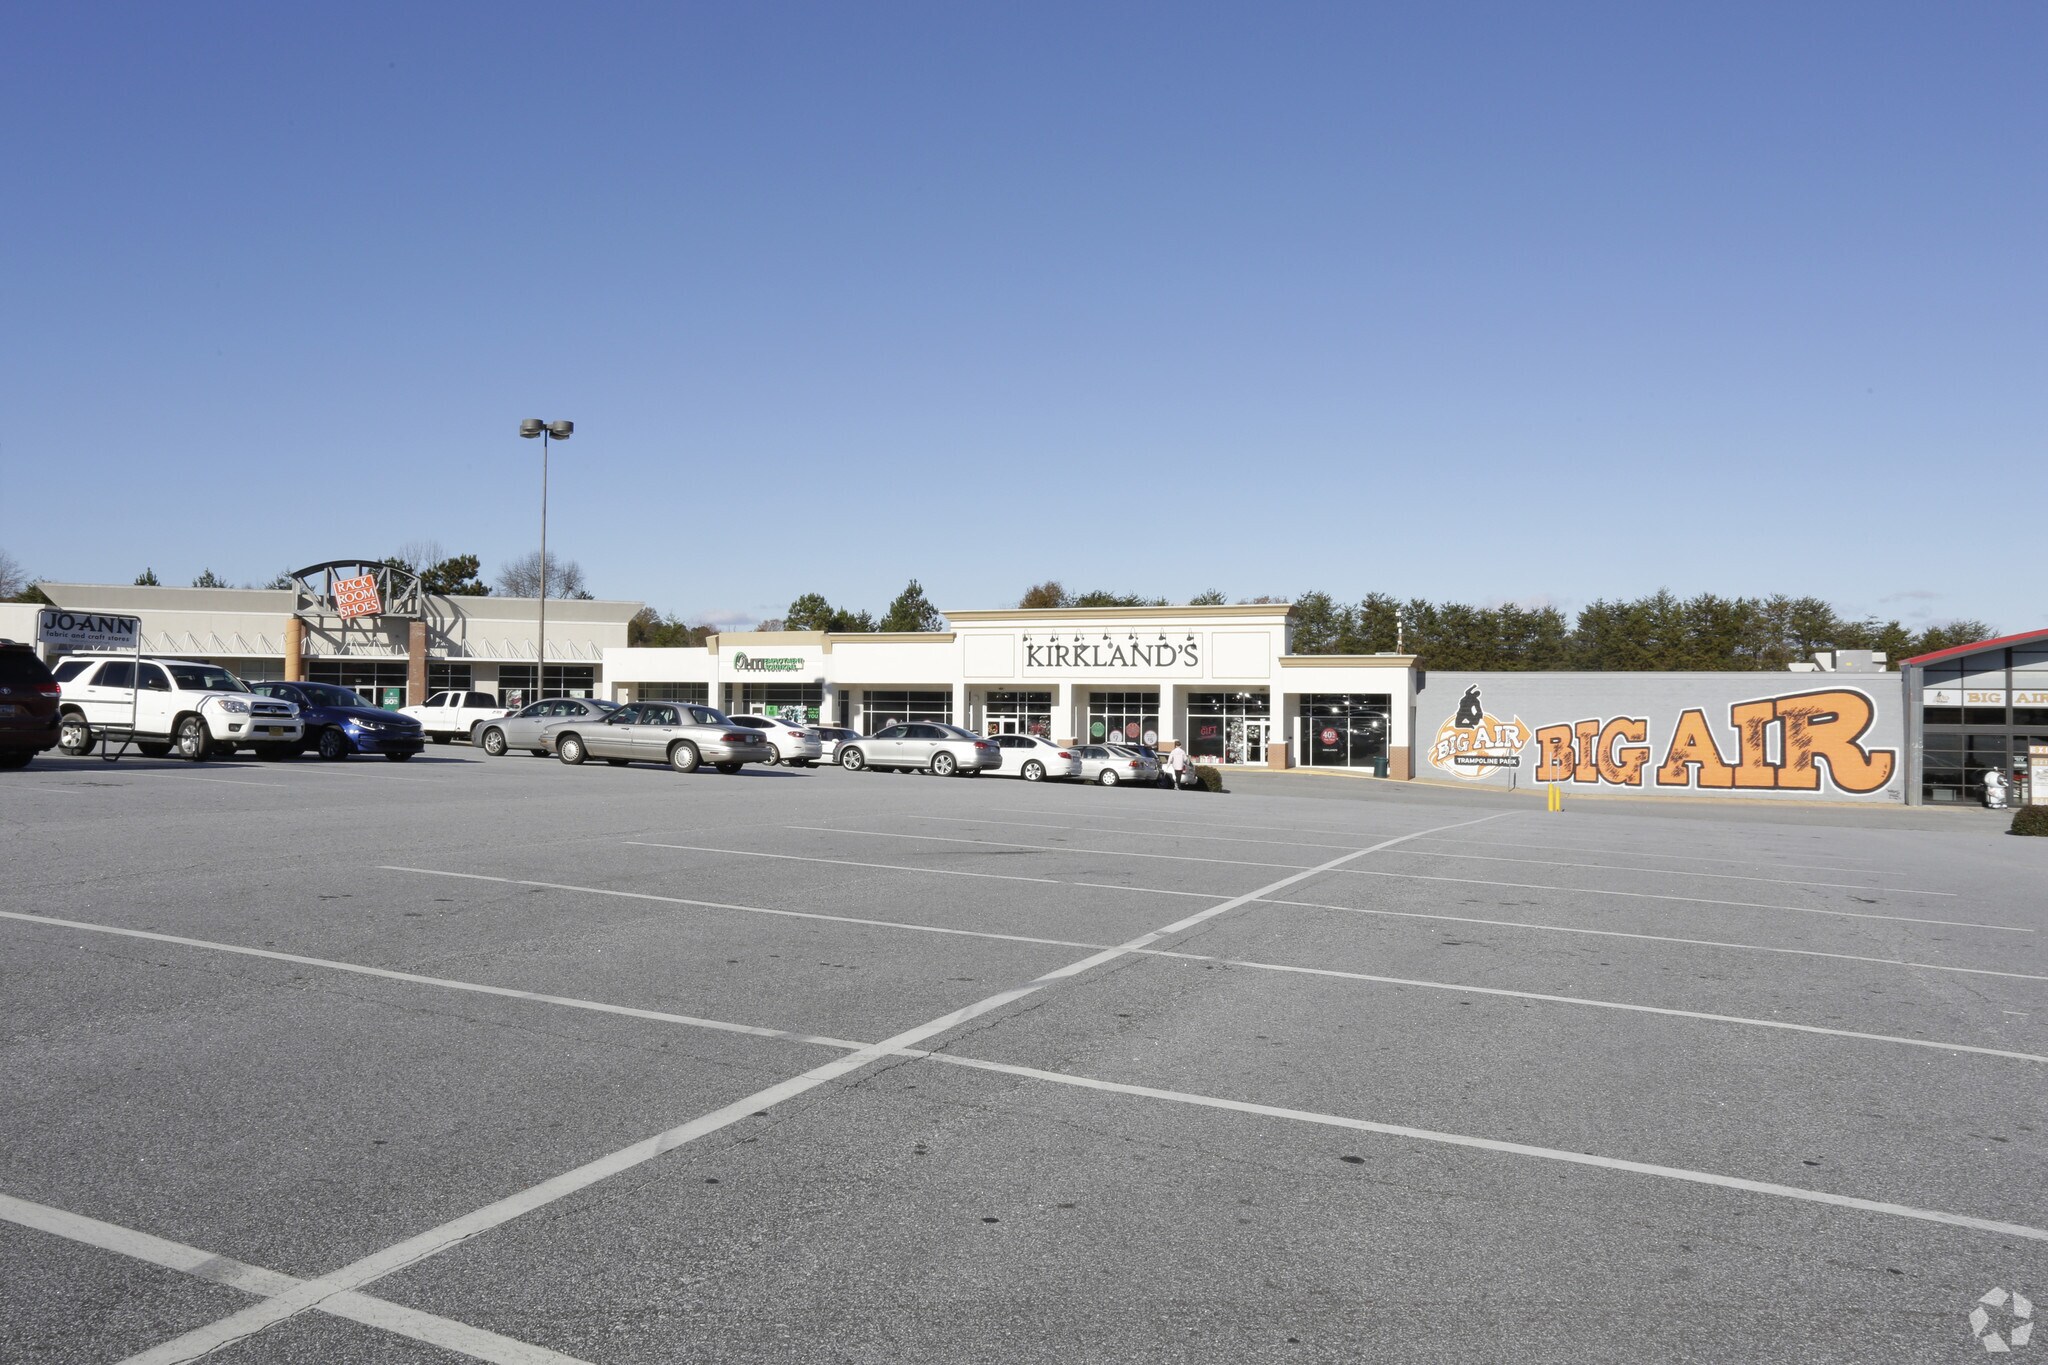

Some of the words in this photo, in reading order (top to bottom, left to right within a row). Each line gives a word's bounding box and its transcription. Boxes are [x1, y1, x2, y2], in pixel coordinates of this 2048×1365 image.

[337, 577, 370, 592] RACK
[338, 587, 376, 604] ROOM
[340, 600, 379, 617] SHOES
[46, 629, 69, 638] fabric
[71, 631, 86, 639] and
[1026, 644, 1199, 668] KIRKLAND'S
[1967, 692, 2002, 704] BIG
[1436, 731, 1470, 761] BIG
[1472, 724, 1523, 749] AIR
[1535, 715, 1651, 787] BIG
[1656, 688, 1896, 795] AIR
[1456, 757, 1498, 765] TRAMPOLINE
[1499, 757, 1517, 765] PARK
